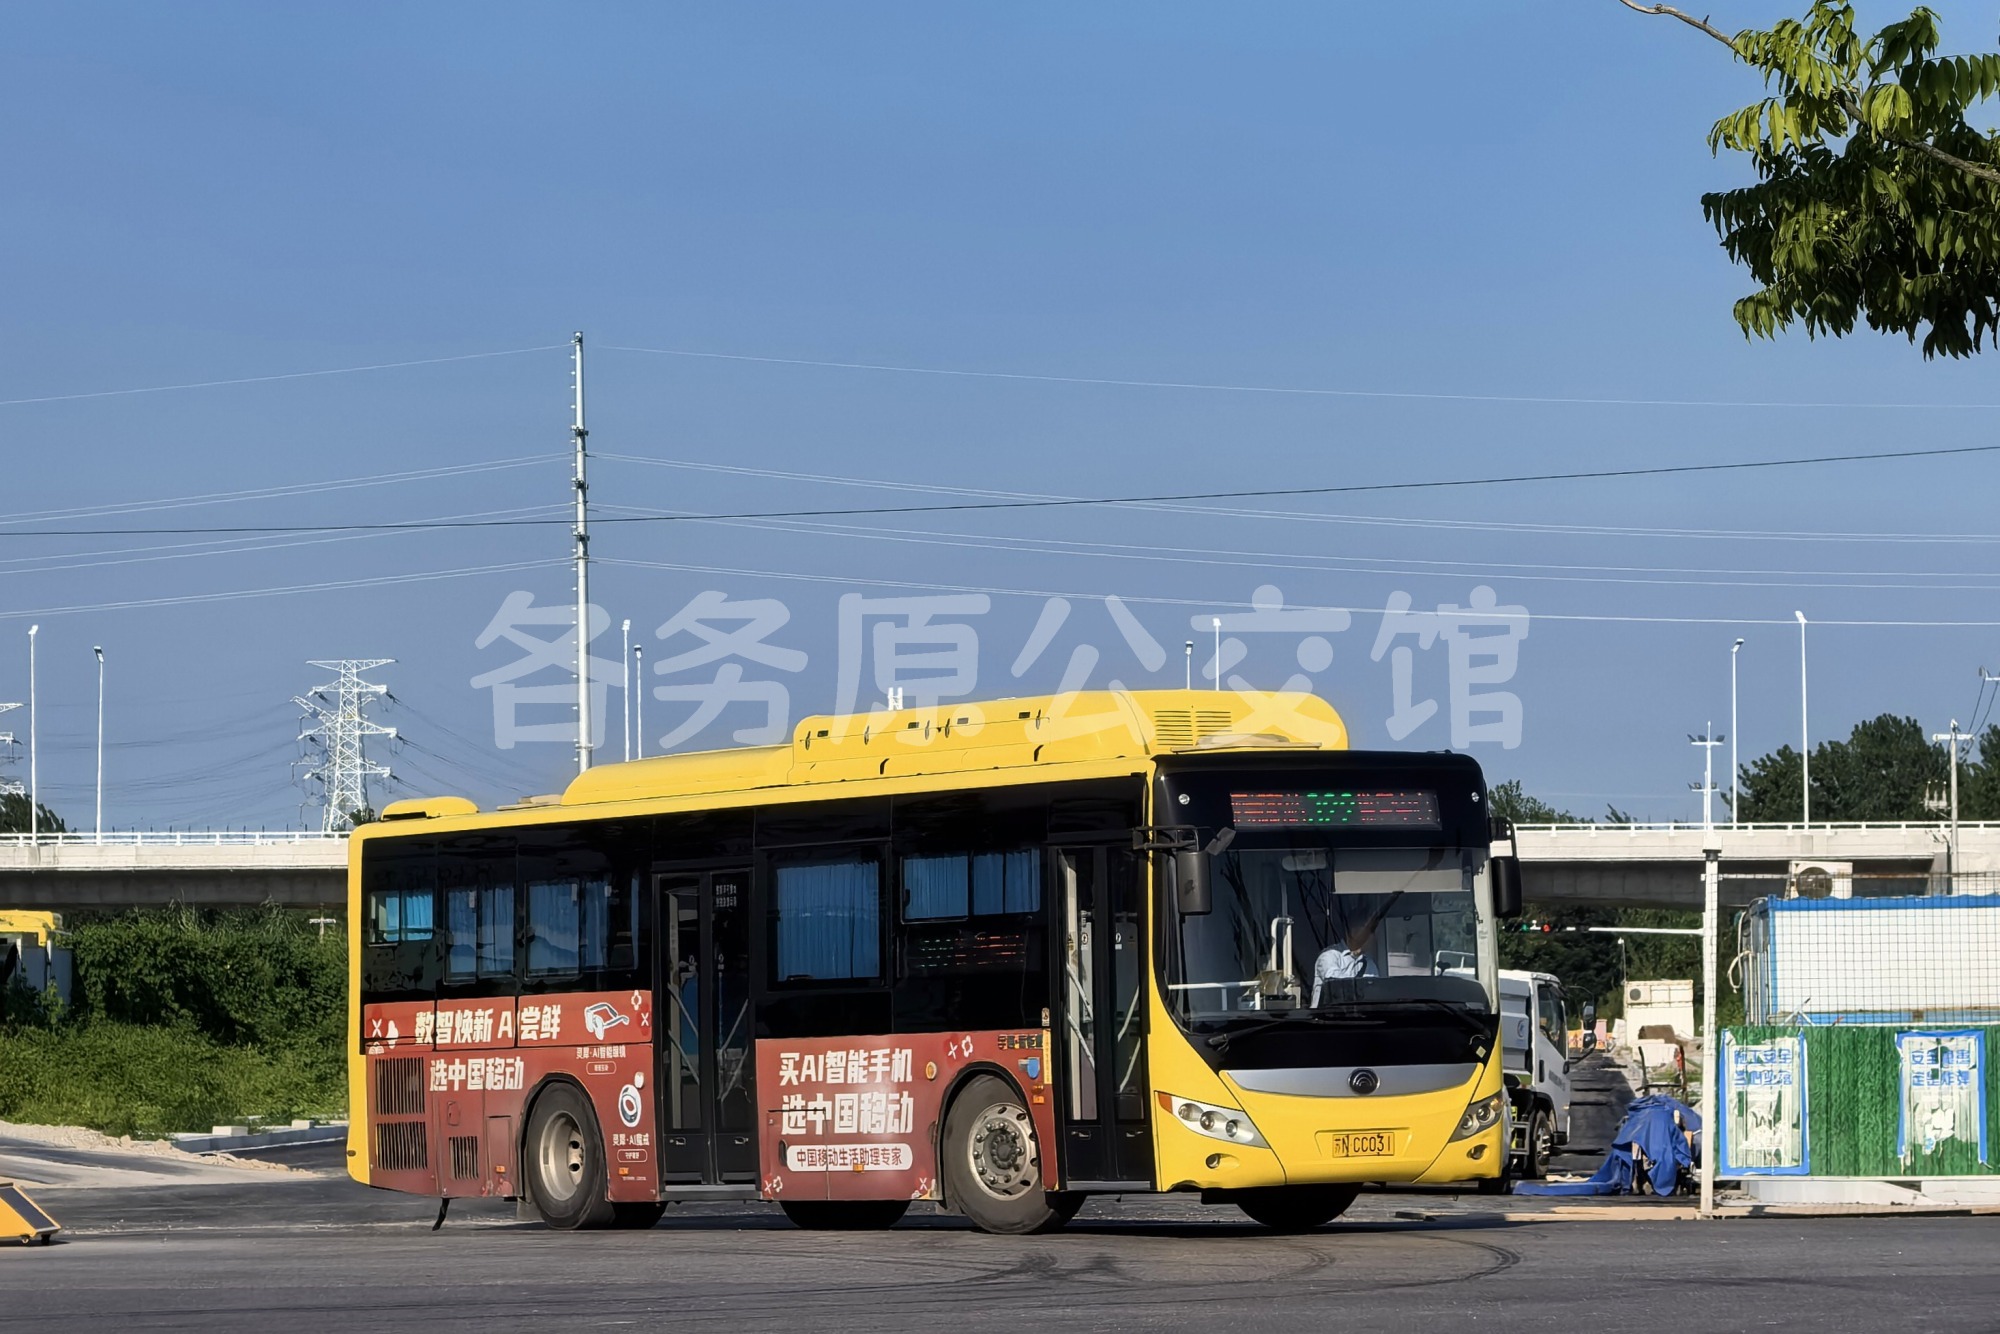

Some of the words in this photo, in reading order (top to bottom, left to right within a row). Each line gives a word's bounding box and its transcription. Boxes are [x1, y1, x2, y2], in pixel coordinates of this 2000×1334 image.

[414, 1008, 494, 1045] 数智焕新
[429, 1056, 524, 1092] 选中国移动
[779, 1048, 913, 1086] 买AI智能手机
[781, 1091, 914, 1135] 选中国移动
[796, 1147, 904, 1167] 中国移动生活助理专家
